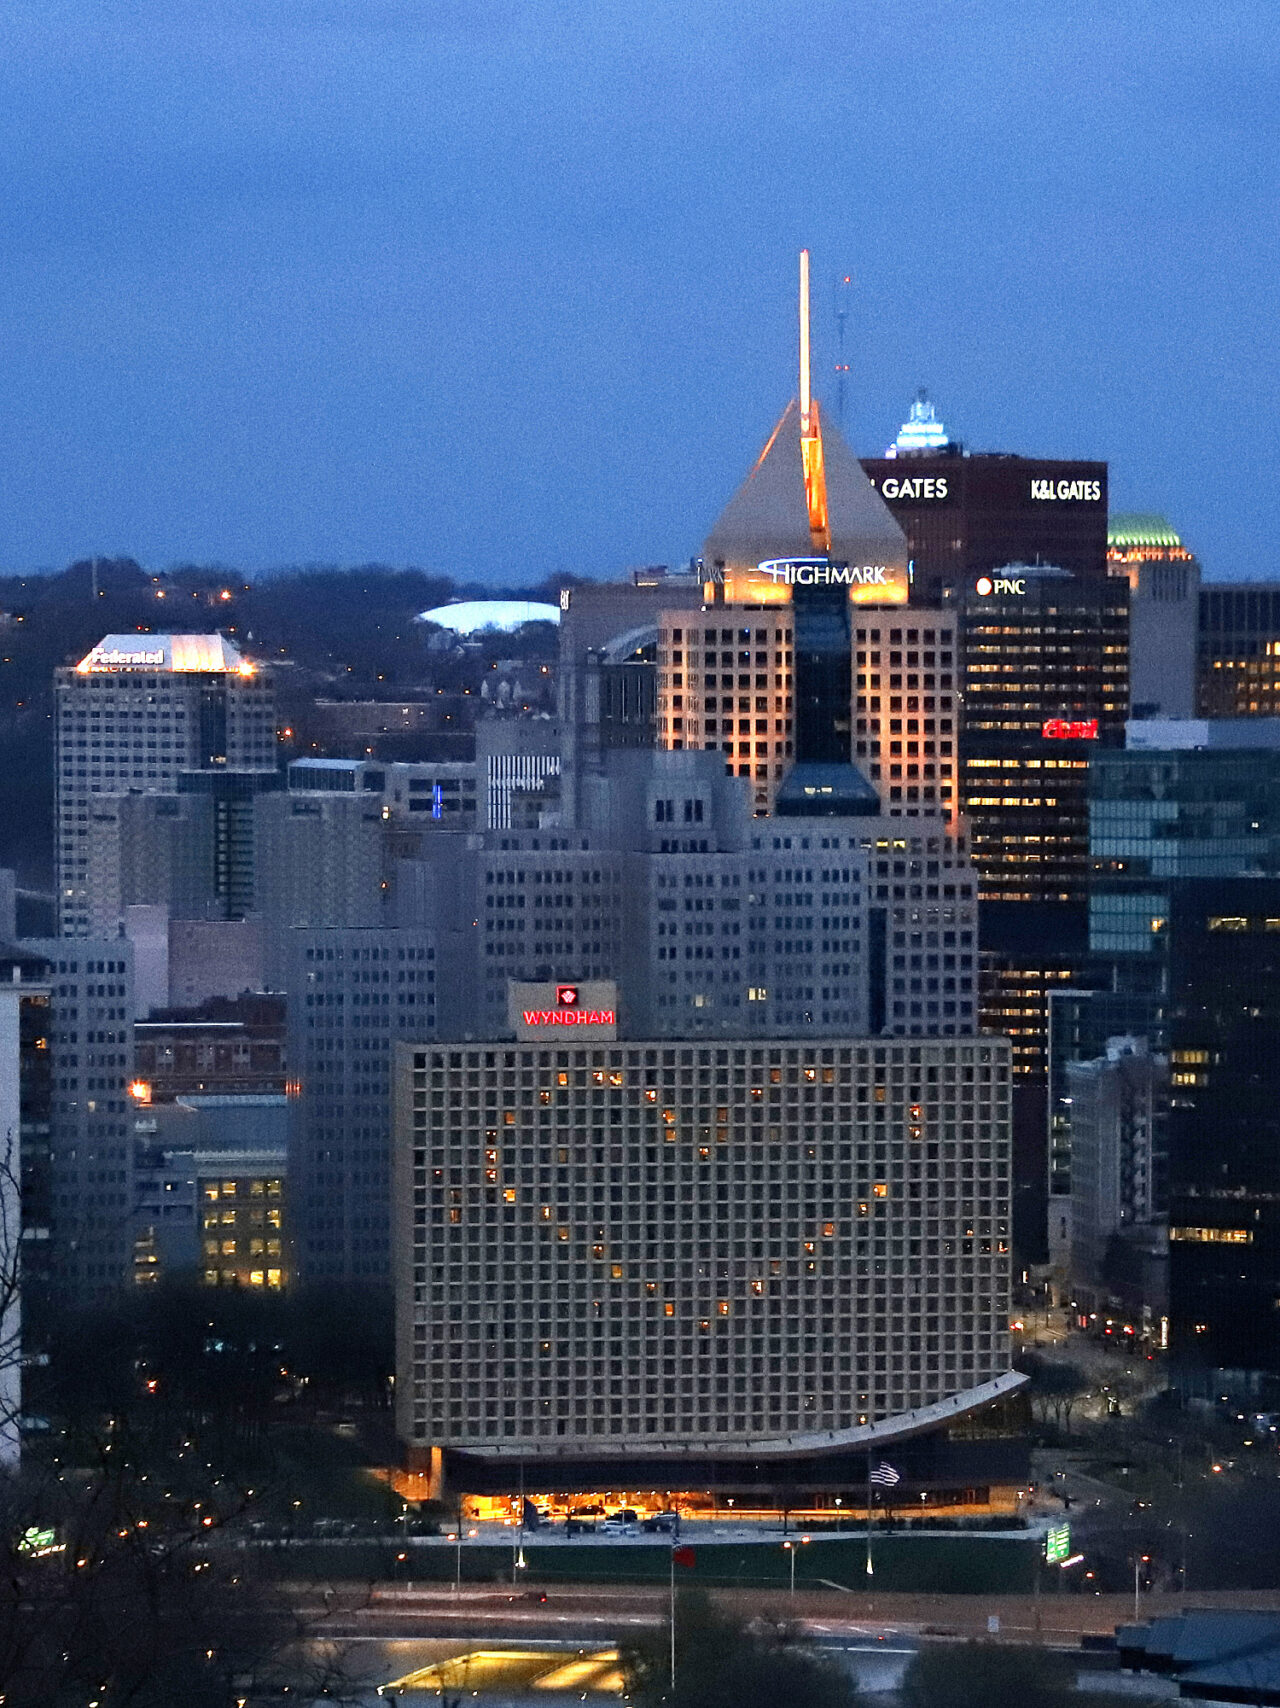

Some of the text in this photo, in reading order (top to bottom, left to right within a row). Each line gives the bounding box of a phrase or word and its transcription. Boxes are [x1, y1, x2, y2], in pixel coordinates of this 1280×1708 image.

[881, 478, 948, 499] GATES
[1031, 479, 1101, 501] K&L GATES
[773, 563, 887, 586] HIGHMARK
[993, 579, 1025, 595] PNC
[92, 647, 164, 664] Federated
[523, 1010, 615, 1025] WYNDHAM
